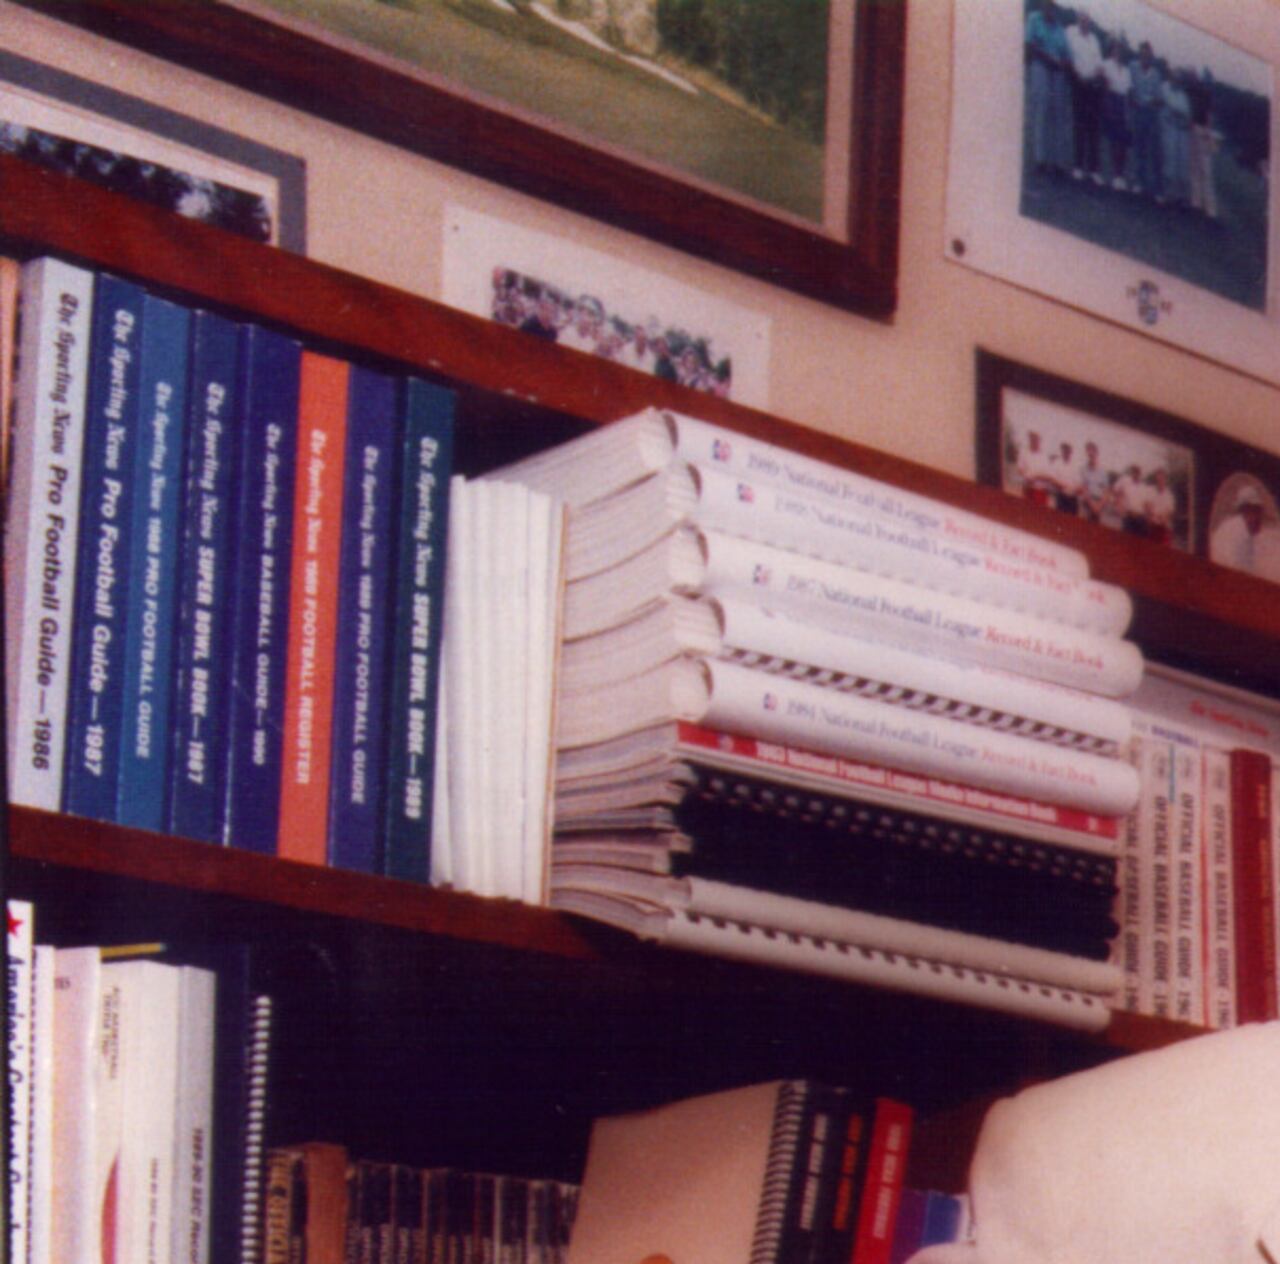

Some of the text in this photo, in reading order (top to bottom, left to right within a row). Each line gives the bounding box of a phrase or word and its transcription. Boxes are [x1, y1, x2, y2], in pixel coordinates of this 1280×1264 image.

[50, 331, 76, 404] Sporting
[104, 344, 131, 420] Sporting
[51, 408, 70, 455] News
[105, 423, 126, 470] News
[149, 412, 170, 471] Sporting
[199, 418, 223, 490] Sporting
[47, 464, 68, 505] Pro
[101, 477, 122, 519] Pro
[413, 471, 435, 540] Sporting
[42, 513, 64, 611] Football
[94, 523, 119, 618] Football
[144, 556, 161, 596] PRO
[197, 546, 214, 605] SUPER
[258, 554, 274, 648] BASEBALL
[358, 613, 371, 648] PRO
[412, 594, 429, 649] SUPER
[37, 617, 58, 686] Guide
[89, 624, 112, 693] Guide
[139, 598, 158, 695] FOOTBALL
[193, 609, 211, 660] BOWL
[300, 597, 317, 690] FOOTBALL
[354, 653, 370, 744] FOOTBALL
[410, 653, 427, 702] BOWL
[33, 718, 52, 770] 1986
[84, 725, 104, 777] 1987
[136, 701, 151, 759] GUIDE
[297, 696, 313, 784] REGISTER
[352, 750, 365, 804] GUIDE
[1154, 796, 1169, 858] OFFICIAL
[1180, 792, 1194, 854] OFFICIAL
[1153, 863, 1169, 935] BASEBALL
[1178, 860, 1193, 932] BASEBALL
